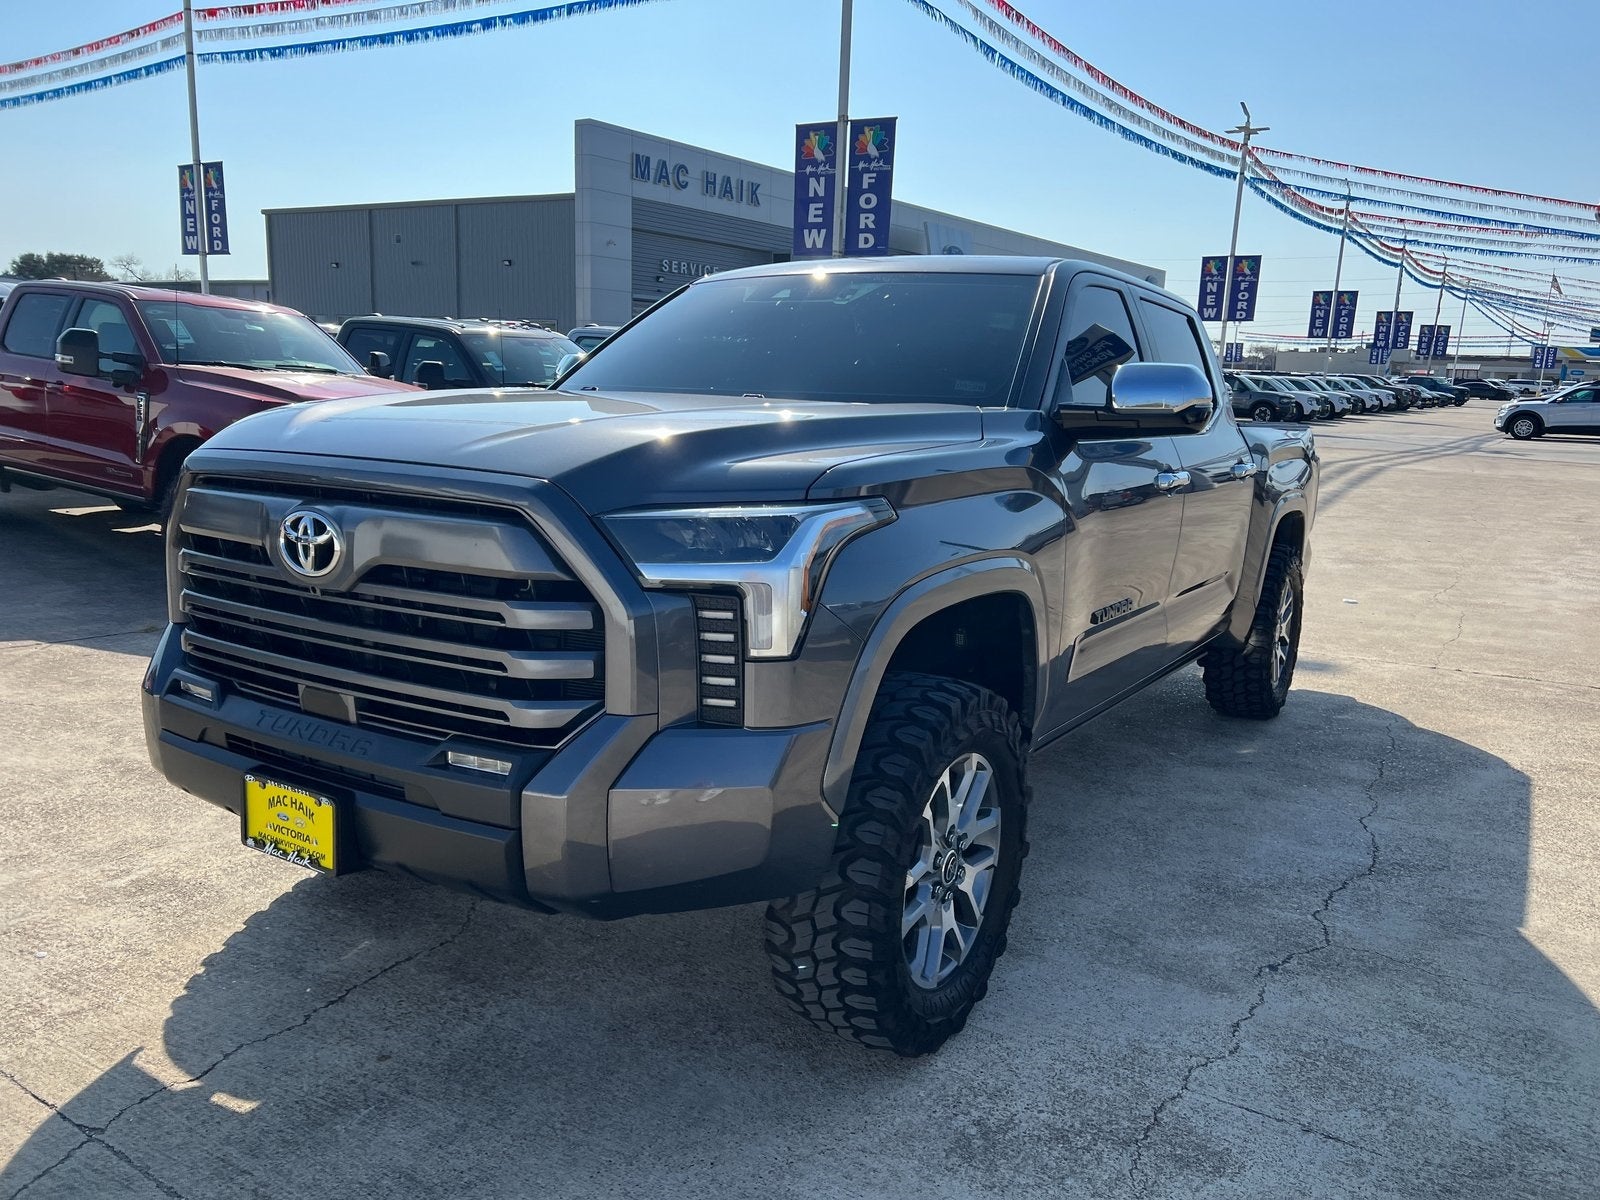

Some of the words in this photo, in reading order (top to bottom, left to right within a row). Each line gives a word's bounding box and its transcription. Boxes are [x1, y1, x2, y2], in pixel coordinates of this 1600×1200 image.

[632, 152, 689, 191] MAC
[704, 171, 761, 207] HAIK
[185, 200, 198, 250] NEW
[803, 177, 826, 249] NEW
[858, 173, 878, 249] FORD
[211, 200, 223, 251] FORD
[1203, 282, 1217, 318] NEW
[1236, 282, 1249, 319] FORD
[1313, 310, 1324, 336] NEW
[1338, 310, 1348, 337] FORD
[1376, 325, 1386, 347] NEW
[1397, 325, 1406, 347] FORD
[1420, 336, 1428, 354] NEW
[1436, 337, 1444, 355] FORD
[1093, 598, 1133, 624] TUNDRA
[256, 709, 373, 757] TUNDRA
[268, 795, 288, 810] MAC
[290, 796, 315, 824] HAIK
[272, 823, 311, 845] VICTORIA
[263, 842, 285, 858] Mac
[287, 850, 315, 869] Haik
